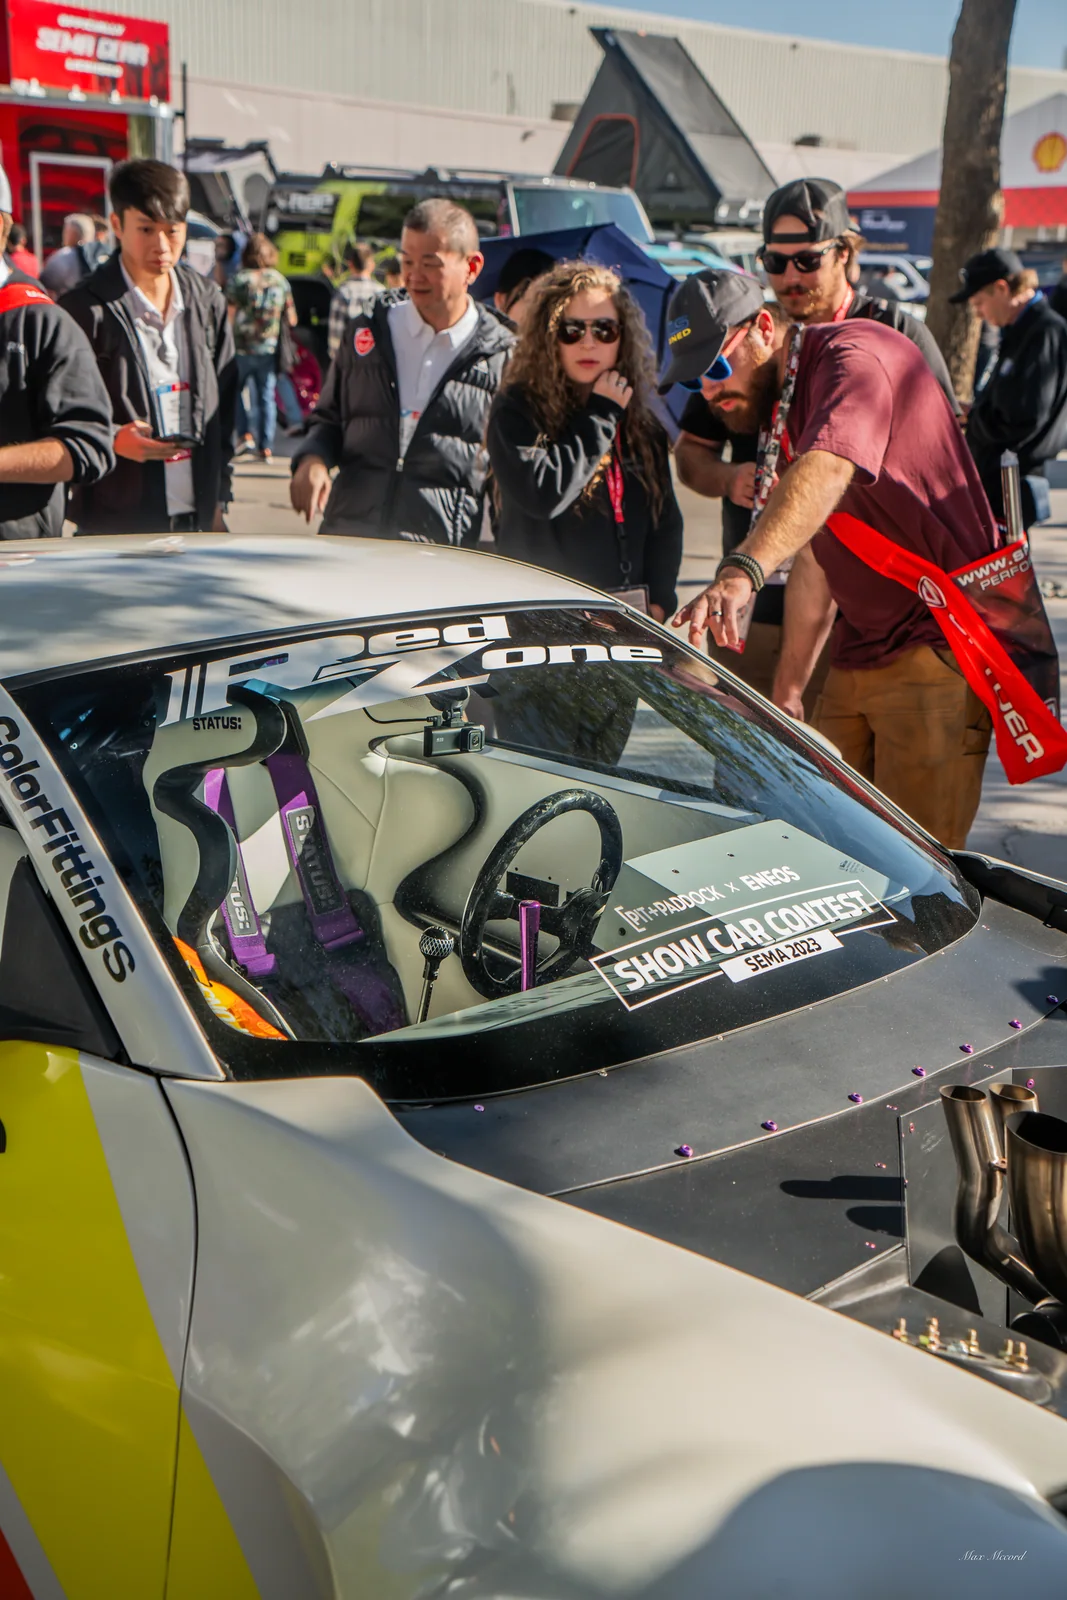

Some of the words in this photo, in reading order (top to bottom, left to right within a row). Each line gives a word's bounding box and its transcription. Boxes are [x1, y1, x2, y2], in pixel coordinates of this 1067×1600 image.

[739, 865, 801, 892] ENEOS
[613, 934, 713, 993] SHOW
[706, 917, 777, 955] CAR
[763, 890, 875, 936] CONTEST
[744, 947, 791, 973] SEMA
[790, 936, 823, 958] 2023
